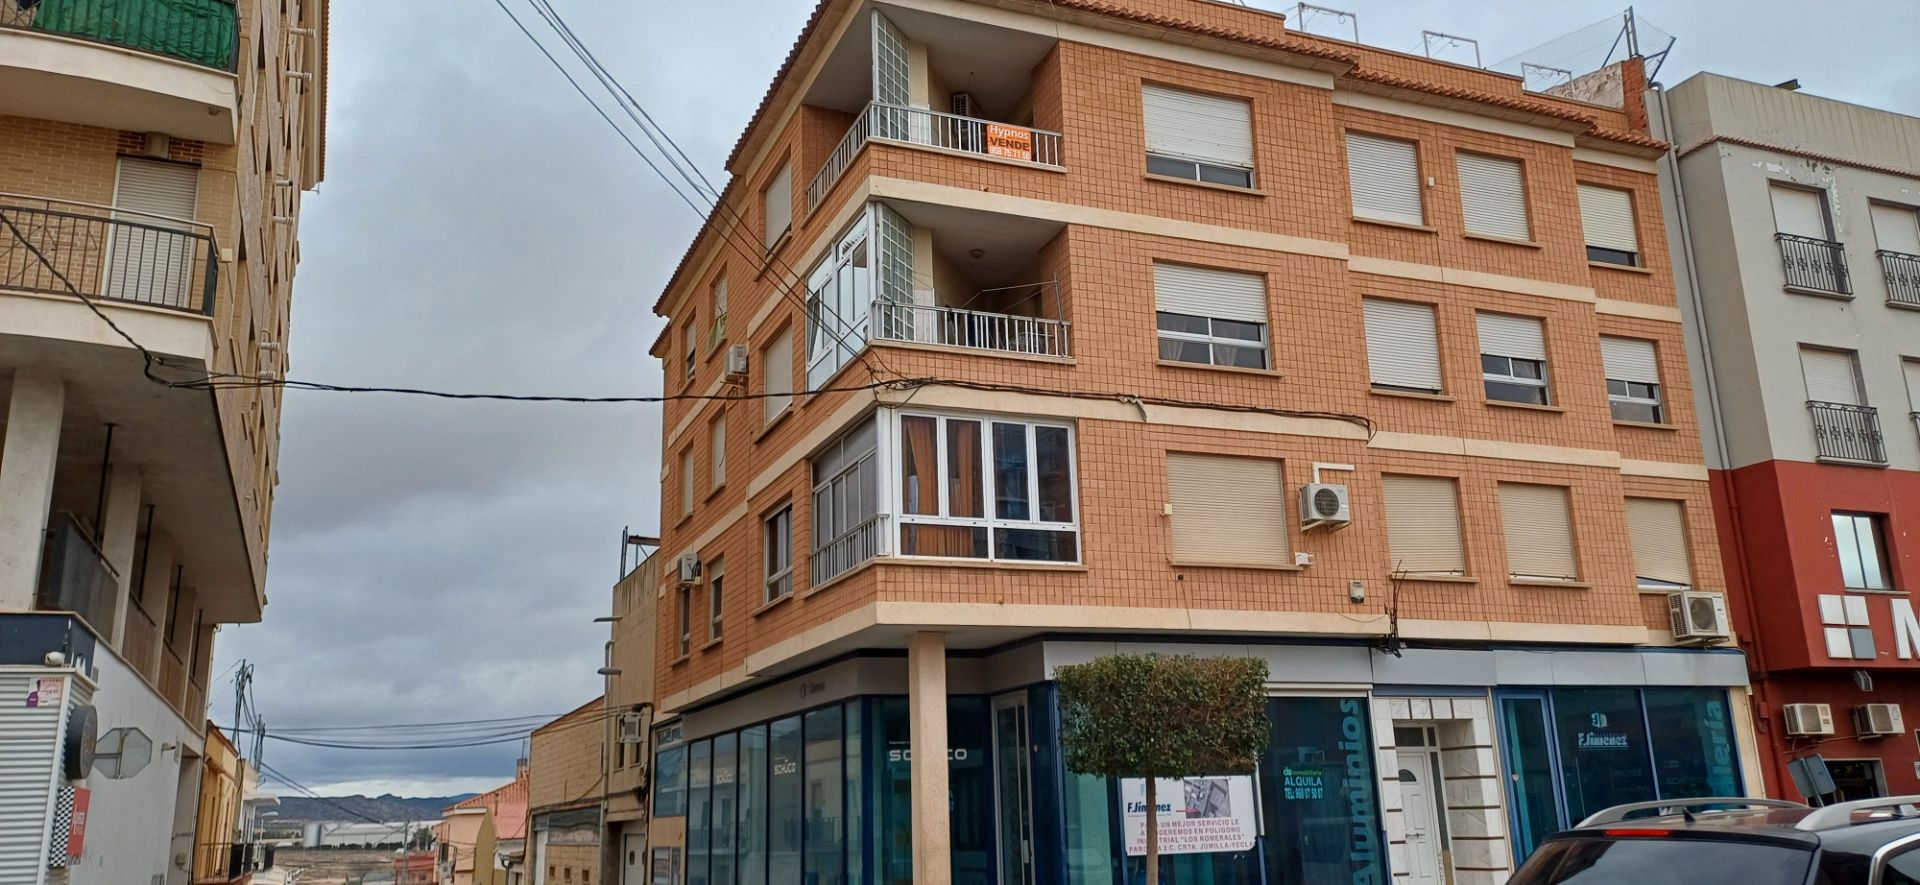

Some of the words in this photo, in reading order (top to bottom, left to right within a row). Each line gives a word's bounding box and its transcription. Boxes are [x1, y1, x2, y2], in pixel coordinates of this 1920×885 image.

[990, 124, 1028, 139] Hypnos
[989, 136, 1029, 151] VENDE
[1284, 776, 1322, 786] ALQUILA
[1127, 801, 1171, 813] F.Jimnez
[1172, 820, 1196, 828] MEJOR
[1198, 819, 1230, 827] SERVICIO
[1205, 826, 1241, 834] POLIGONO
